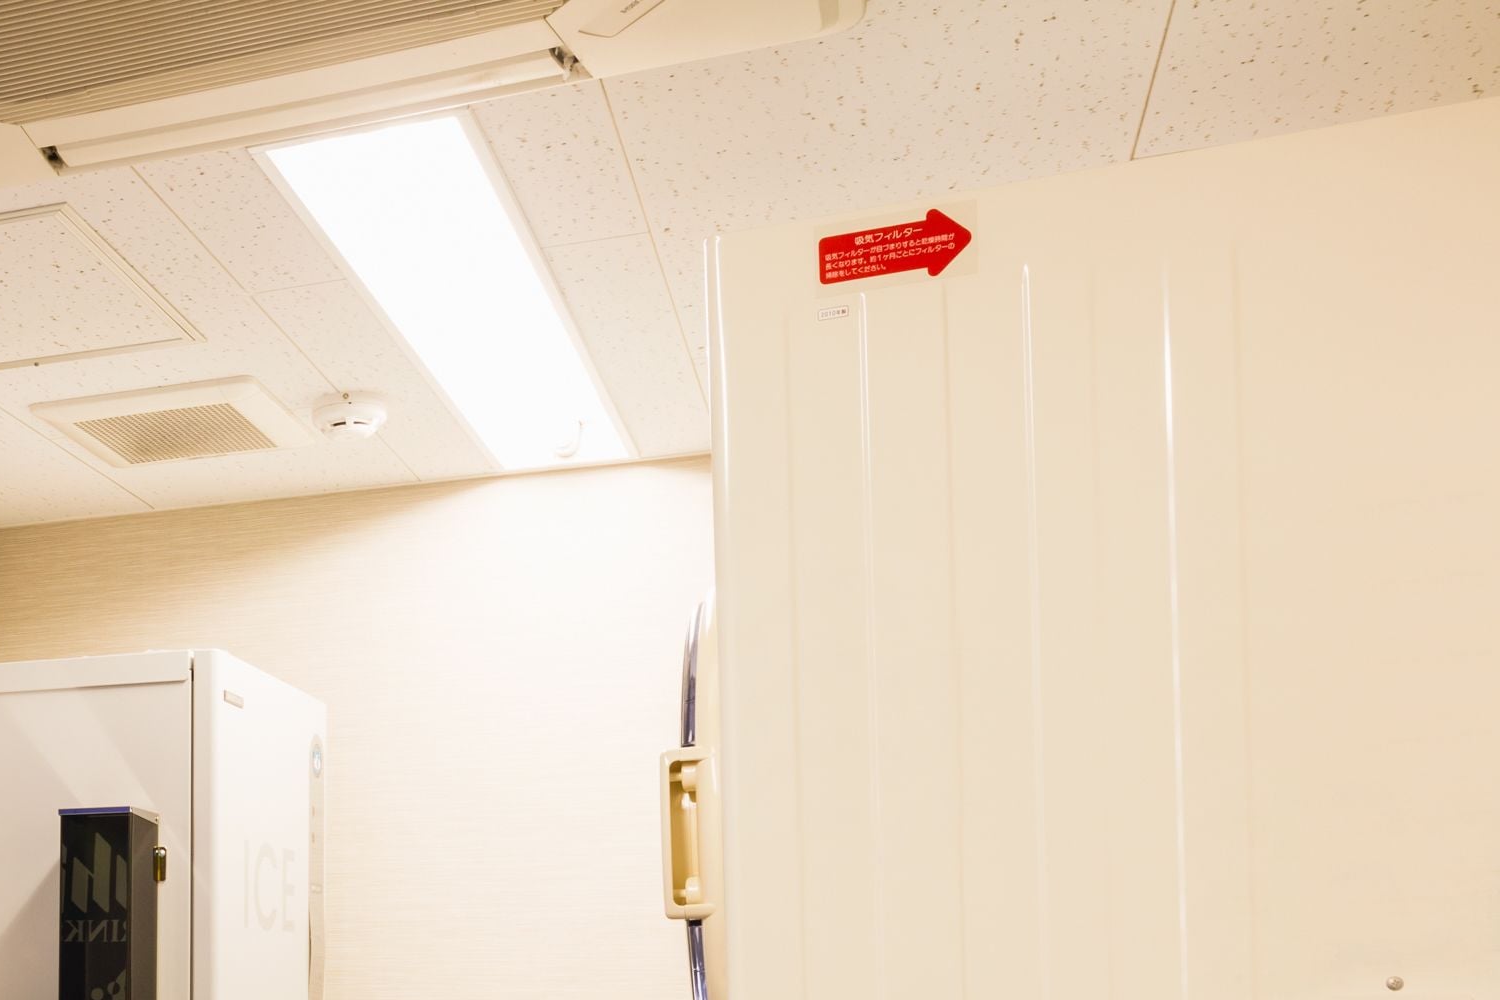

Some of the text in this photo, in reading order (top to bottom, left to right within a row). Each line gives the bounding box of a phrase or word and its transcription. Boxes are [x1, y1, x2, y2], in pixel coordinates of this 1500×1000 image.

[854, 227, 923, 246] 吸気フィルター
[243, 838, 296, 933] ICE
